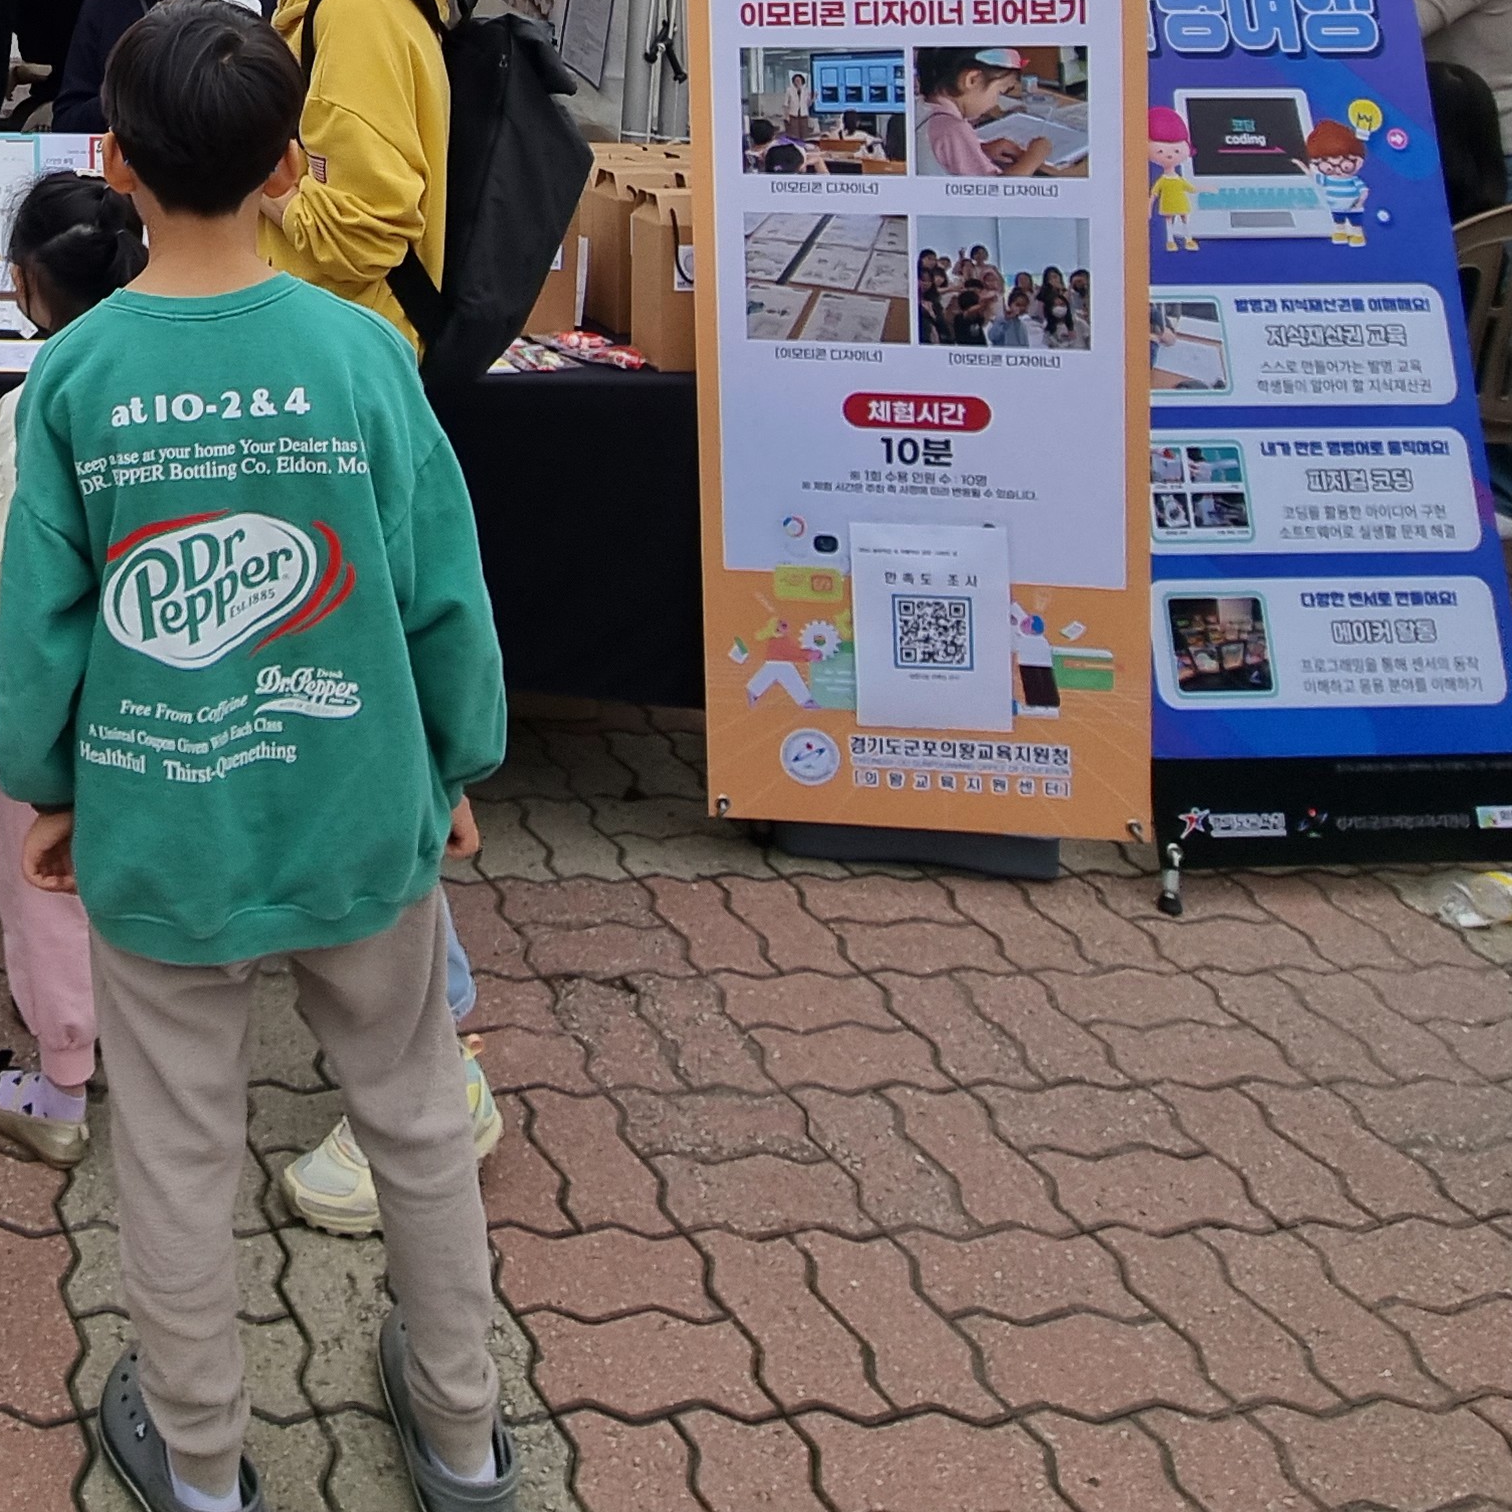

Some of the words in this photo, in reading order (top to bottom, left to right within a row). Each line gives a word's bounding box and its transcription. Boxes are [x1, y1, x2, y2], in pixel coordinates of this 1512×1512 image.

[740, 1, 847, 28] 이모티콘
[855, 0, 964, 26] 디자이너
[1225, 133, 1266, 147] coding
[1265, 323, 1364, 347] 지식재산권
[1366, 324, 1407, 347] 교육
[110, 395, 148, 428] at
[250, 388, 279, 418] &
[285, 387, 312, 417] 4
[867, 400, 966, 426] 체험시간
[142, 448, 157, 464] at
[158, 445, 191, 464] your
[194, 441, 237, 458] home
[239, 438, 276, 455] Your
[279, 437, 330, 454] Dealer
[332, 436, 359, 454] has
[880, 436, 954, 467] 10분
[169, 459, 238, 481] Bottling
[241, 459, 271, 476] Co.
[276, 456, 333, 475] Eldon.
[1306, 468, 1368, 492] 피지컬
[1371, 467, 1414, 492] 코딩
[179, 527, 247, 586] Dr
[125, 544, 294, 647] Pepper
[1331, 619, 1393, 644] 메이커
[119, 699, 151, 718] Free
[155, 702, 194, 725] From
[78, 740, 146, 776] Healthful
[850, 735, 1070, 766] 경기도군포의왕교육지원청
